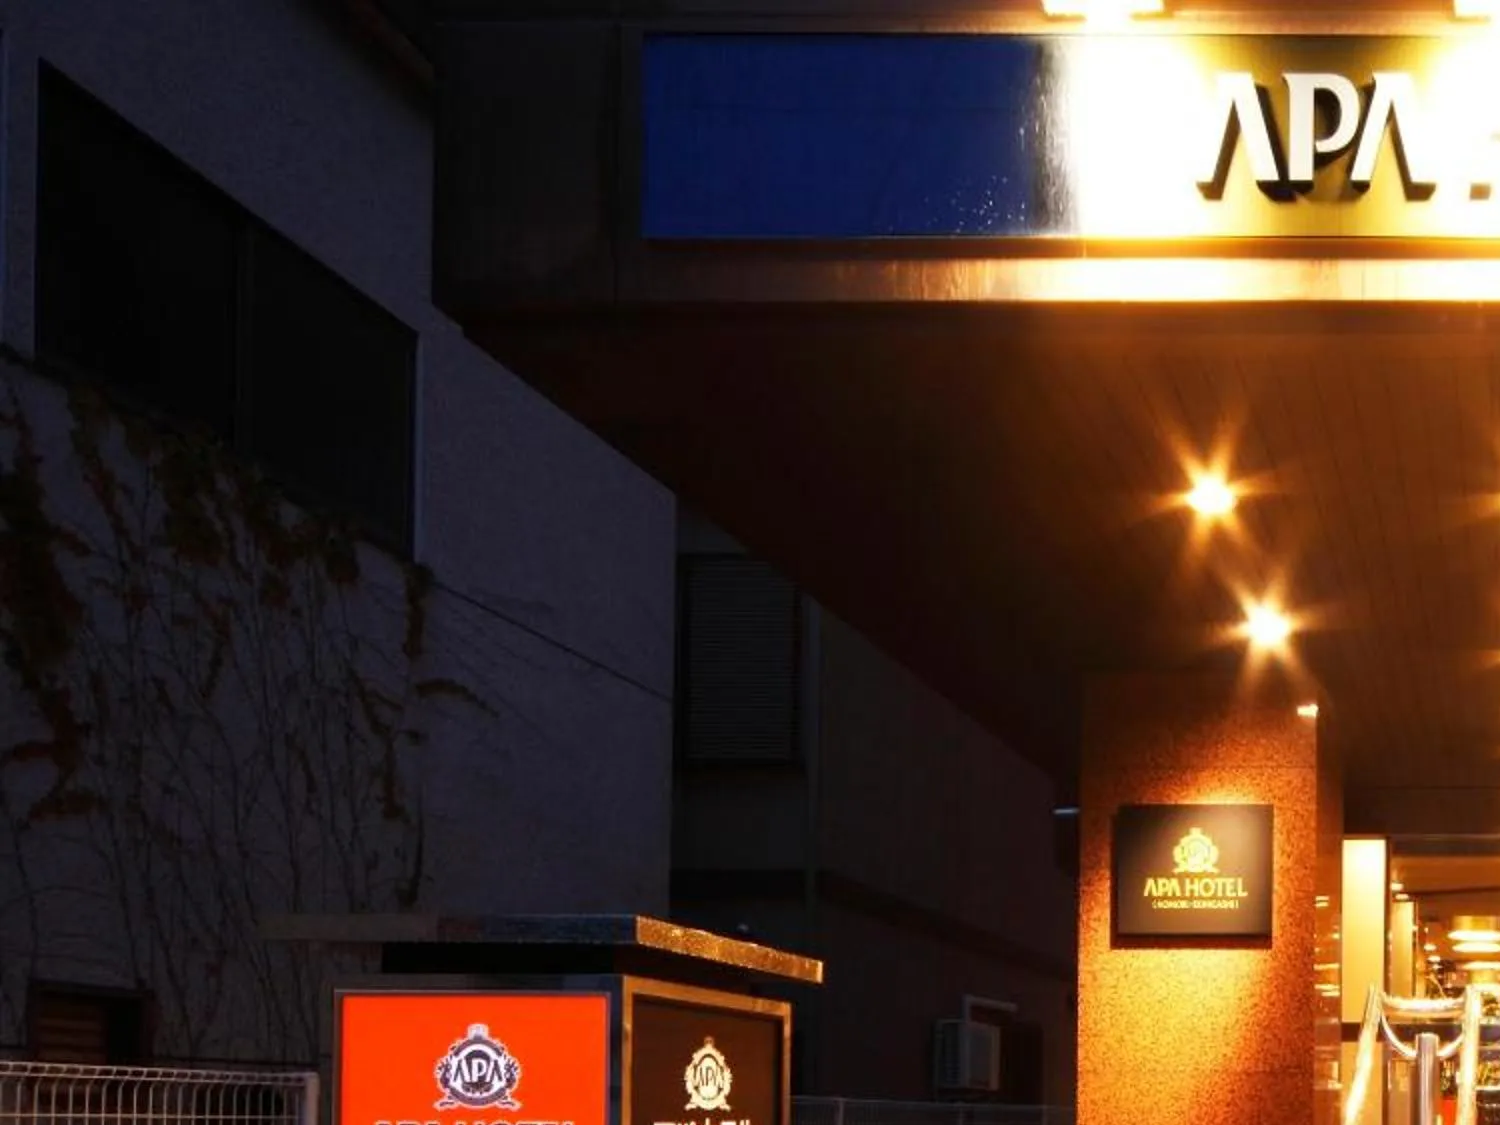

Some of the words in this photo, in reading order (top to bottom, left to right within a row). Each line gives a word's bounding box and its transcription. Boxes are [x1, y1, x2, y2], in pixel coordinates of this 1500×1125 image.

[1197, 72, 1436, 201] APA
[1143, 877, 1181, 897] APA
[1185, 877, 1248, 897] HOTEL
[453, 1058, 502, 1083] APA
